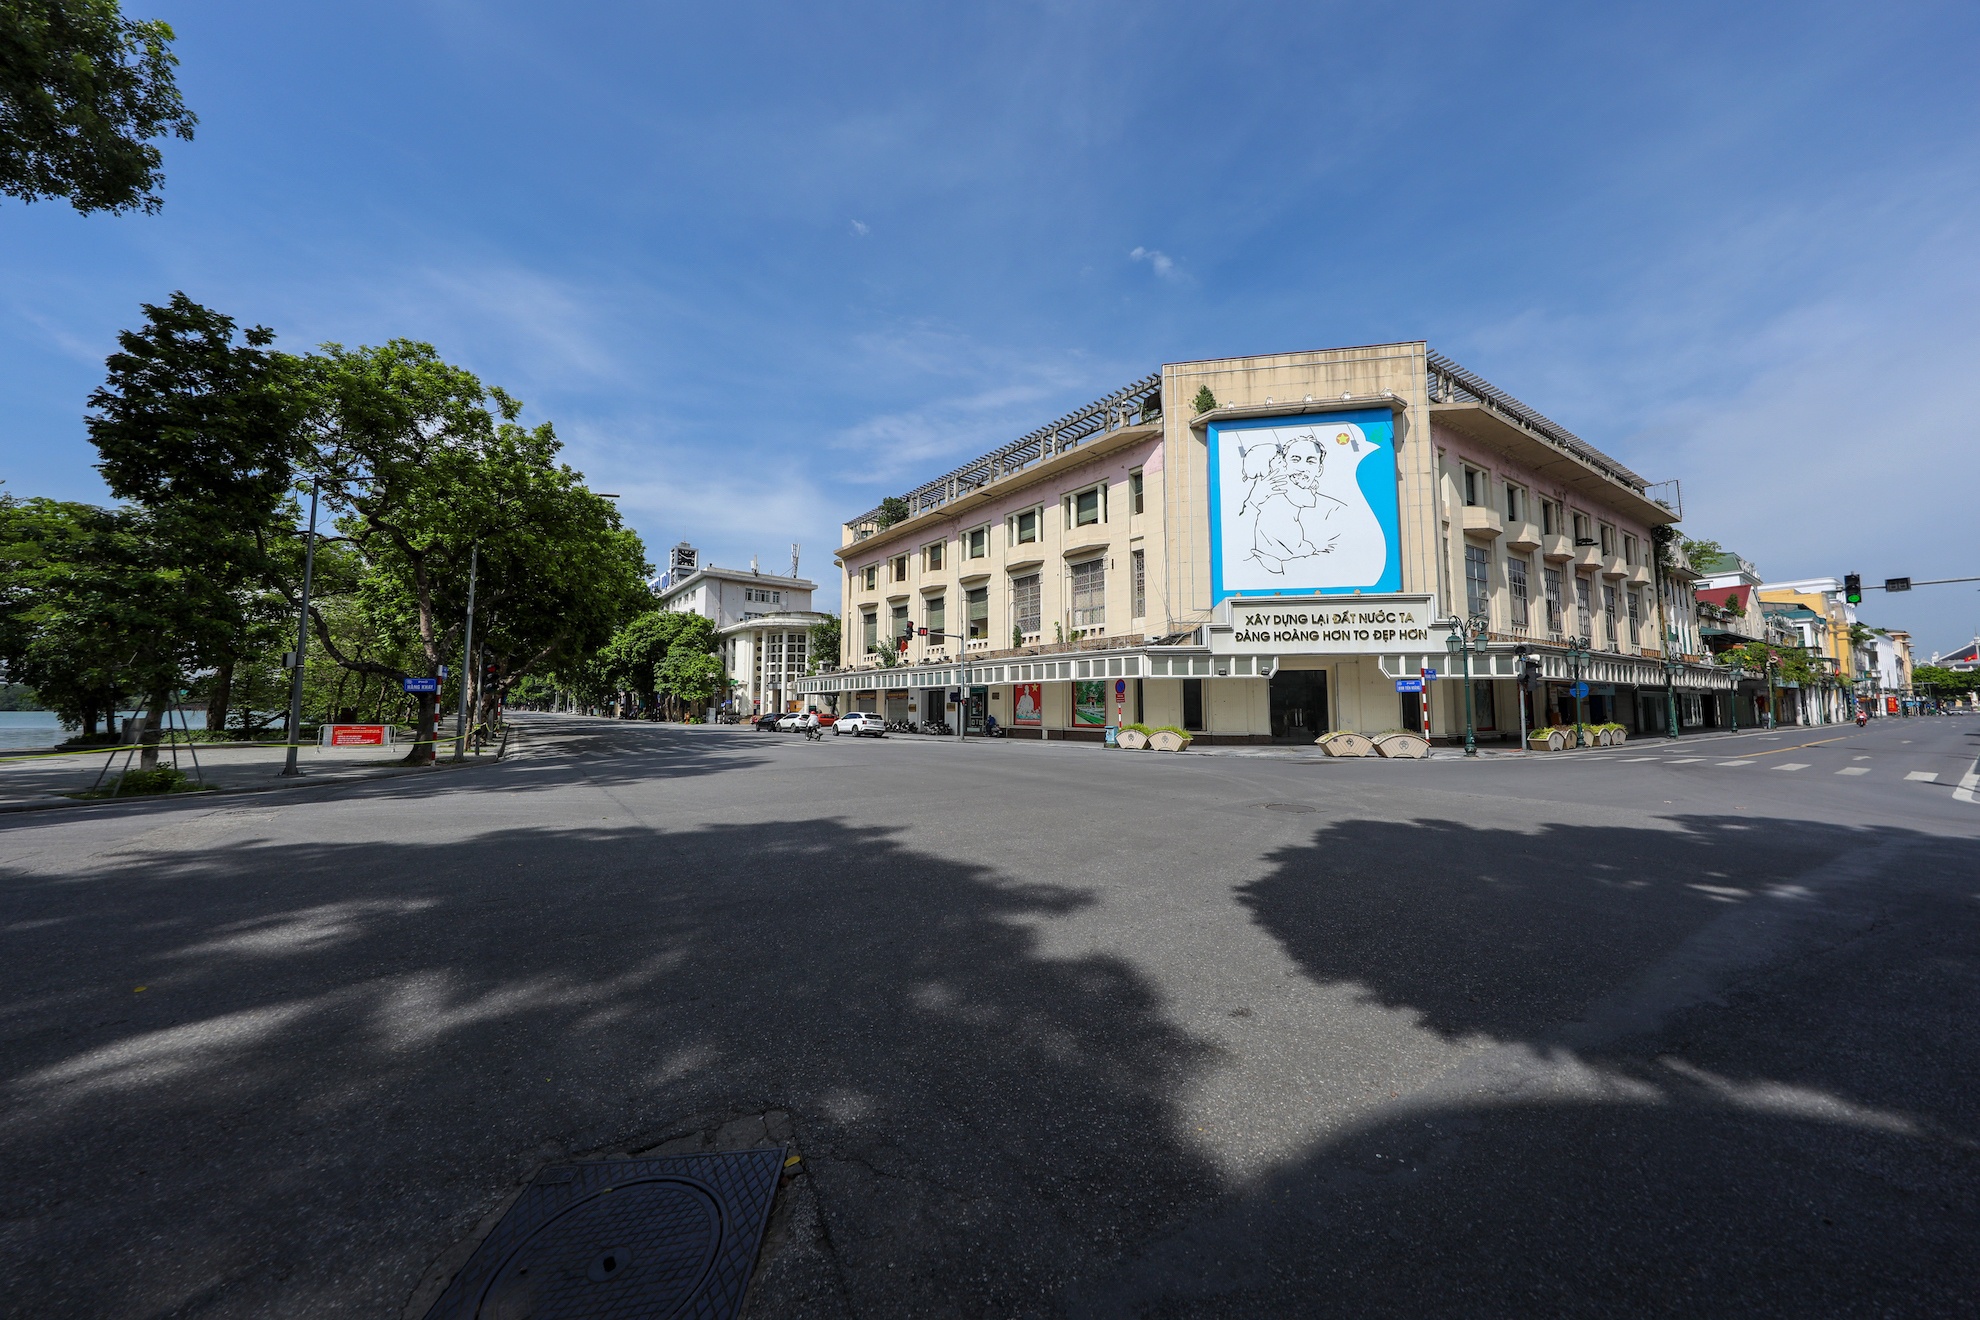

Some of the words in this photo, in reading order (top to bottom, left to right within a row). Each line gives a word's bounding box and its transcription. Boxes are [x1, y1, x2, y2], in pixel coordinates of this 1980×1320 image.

[1245, 613, 1270, 625] XÂY
[1274, 613, 1308, 627] DỰNG
[1311, 613, 1329, 626] LẠI
[1332, 610, 1356, 624] ĐẤT
[1359, 609, 1396, 624] NƯỚC
[1399, 612, 1414, 623] TA
[1235, 629, 1270, 642] ĐÀNG
[1274, 629, 1319, 641] HOÀNG
[1323, 629, 1350, 641] HƠN
[1354, 630, 1369, 641] TO
[1373, 630, 1396, 642] ĐẸP
[1399, 629, 1427, 641] HƠN
